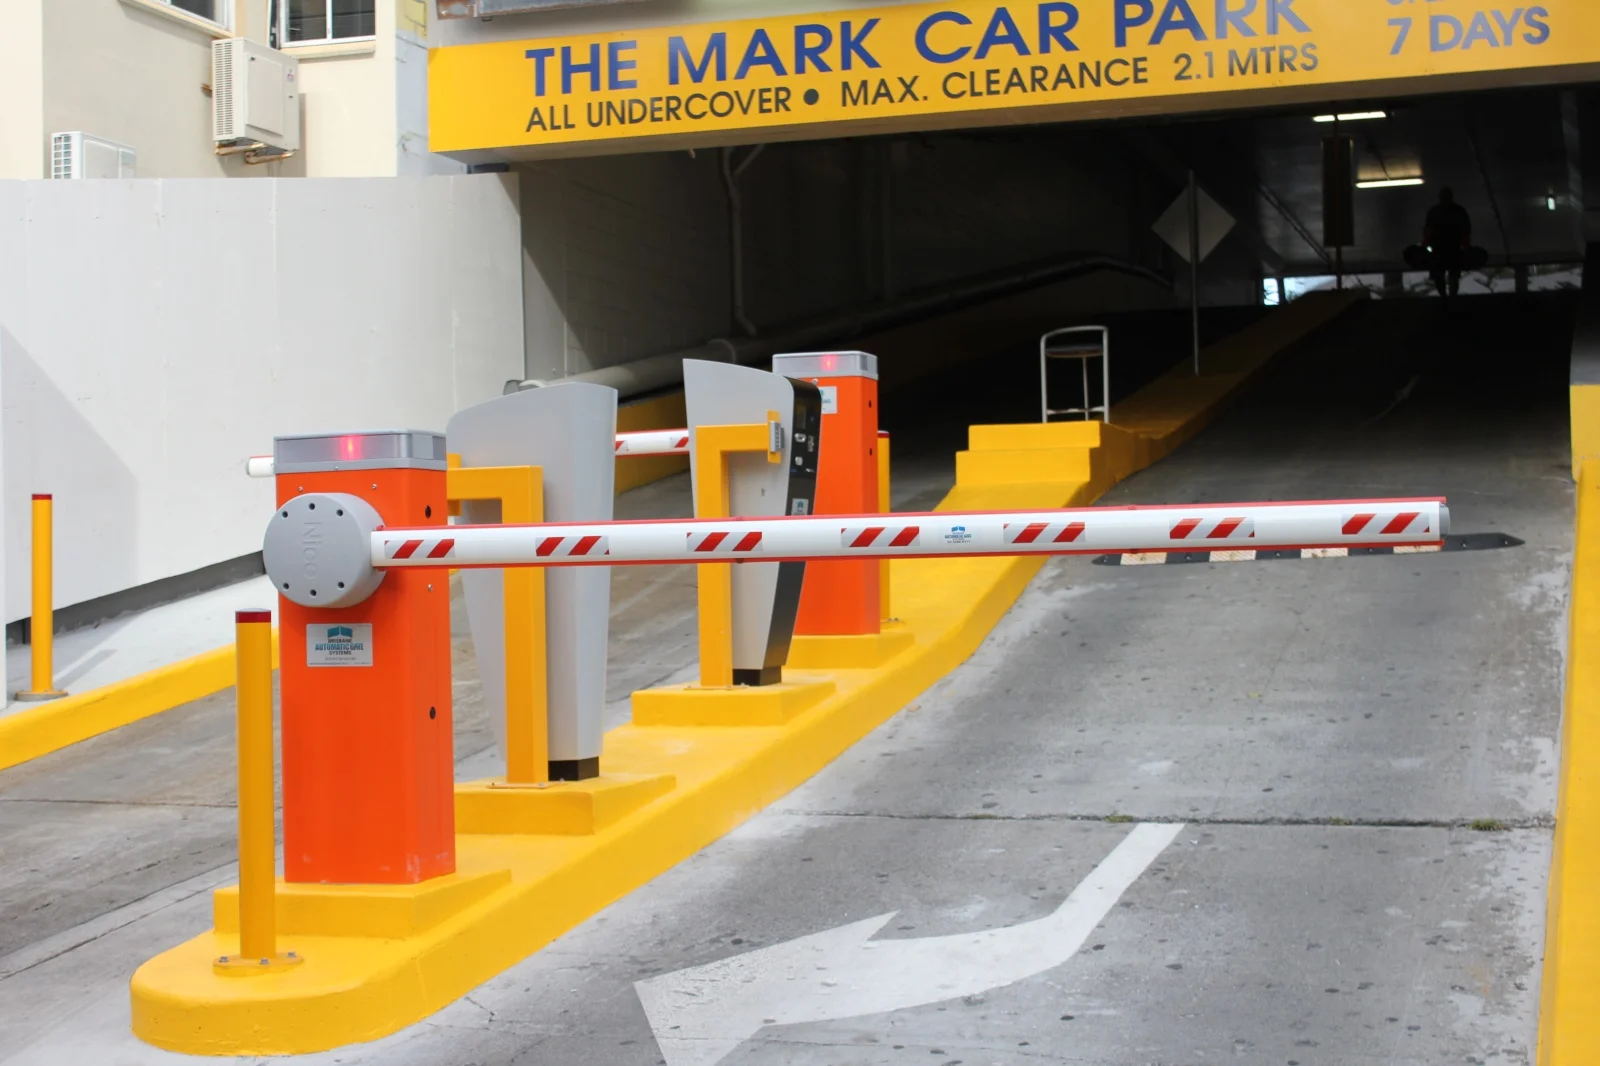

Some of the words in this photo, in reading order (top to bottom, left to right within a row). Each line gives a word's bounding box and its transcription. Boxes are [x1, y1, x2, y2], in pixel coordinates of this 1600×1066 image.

[525, 40, 637, 97] THE
[668, 18, 882, 85] MARK
[915, 2, 1080, 63] CAR
[1114, 0, 1312, 47] PARK
[1387, 17, 1412, 55] 7
[1429, 6, 1550, 52] DAYS
[525, 104, 575, 132] ALL
[587, 86, 791, 127] UNDERCOVER
[841, 75, 928, 107] MAX.
[942, 57, 1148, 99] CLEARANCE
[1173, 51, 1214, 81] 2.1
[1228, 43, 1318, 76] MTRS
[315, 643, 349, 651] AUTOMATIC
